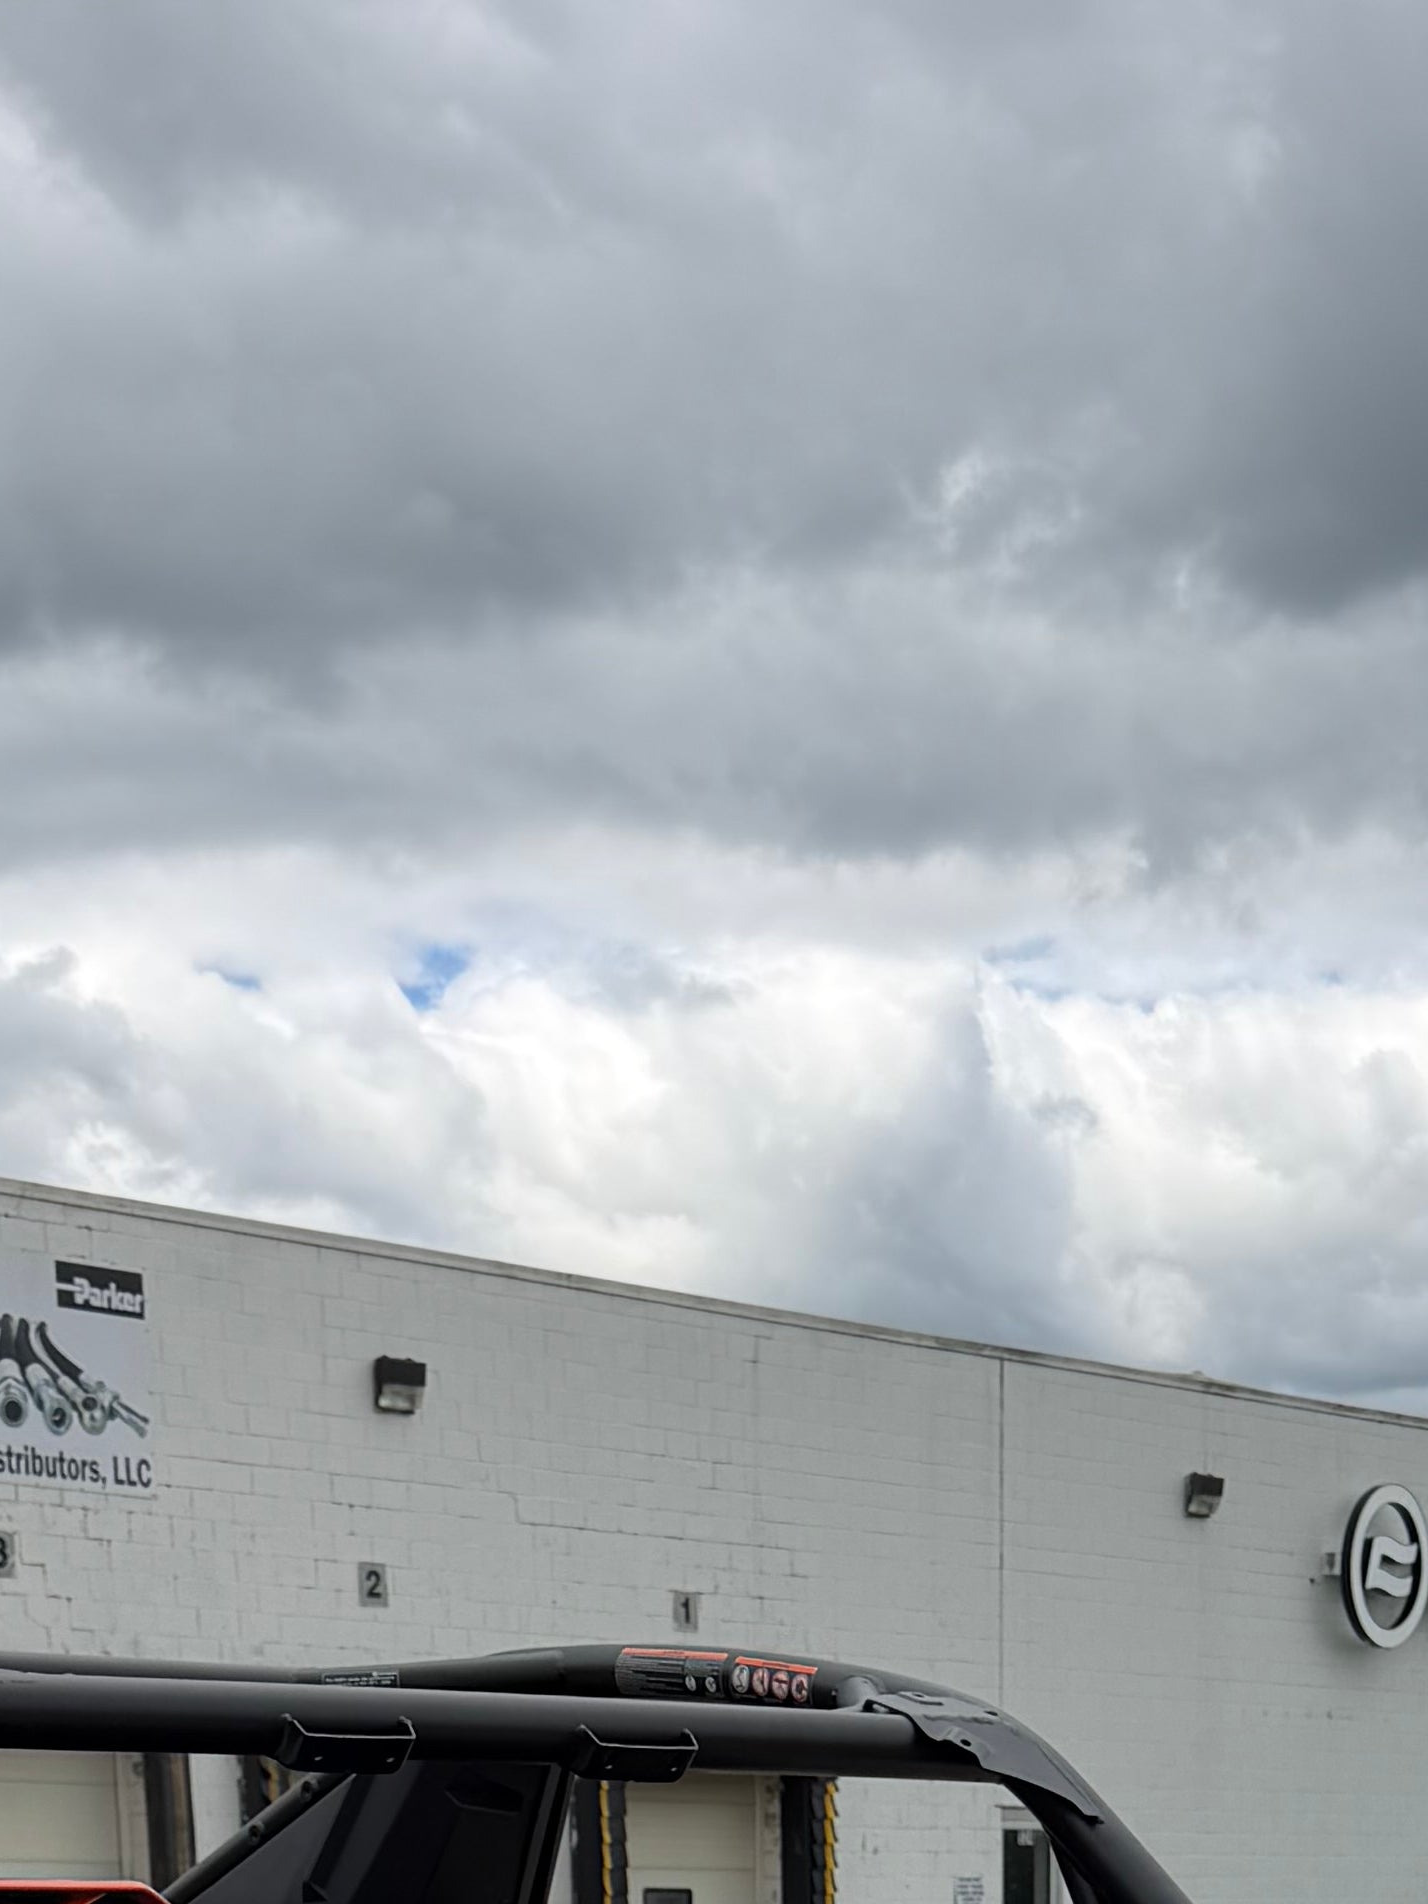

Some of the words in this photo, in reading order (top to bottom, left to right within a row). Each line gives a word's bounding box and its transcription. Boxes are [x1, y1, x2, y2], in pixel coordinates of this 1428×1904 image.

[73, 1276, 144, 1313] Parker
[113, 1456, 152, 1488] LLC
[365, 1569, 382, 1599] 2
[681, 1597, 690, 1624] 1
